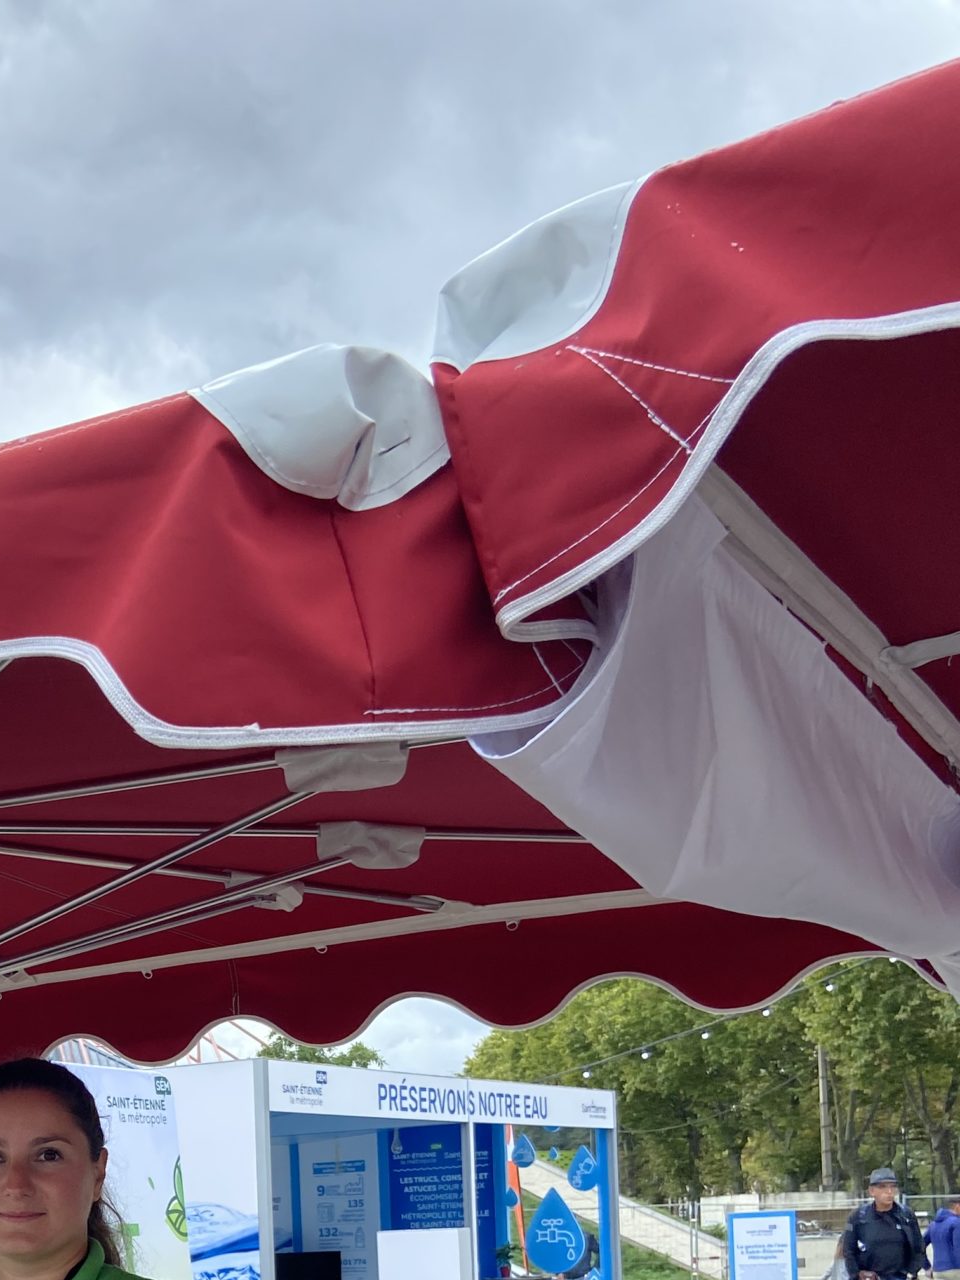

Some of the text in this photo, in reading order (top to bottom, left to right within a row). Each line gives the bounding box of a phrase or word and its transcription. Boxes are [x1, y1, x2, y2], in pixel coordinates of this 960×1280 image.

[282, 1083, 323, 1096] SAINT-ÉTIENNE
[106, 1095, 167, 1111] SAINT-ÉTIENNE
[377, 1078, 548, 1120] PRÉSERVONS NOTRE EAU
[119, 1110, 168, 1127] la métropole
[400, 1177, 414, 1185] LES
[479, 1172, 489, 1180] ET
[317, 1185, 326, 1197] 9
[403, 1183, 460, 1193] ASTUCES POUR
[409, 1192, 458, 1202] ÉCONOMISER
[347, 1199, 365, 1208] 135
[417, 1202, 464, 1210] SAINT-ÉTIEN
[401, 1211, 447, 1221] MÉTROPOLE
[318, 1227, 338, 1238] 132
